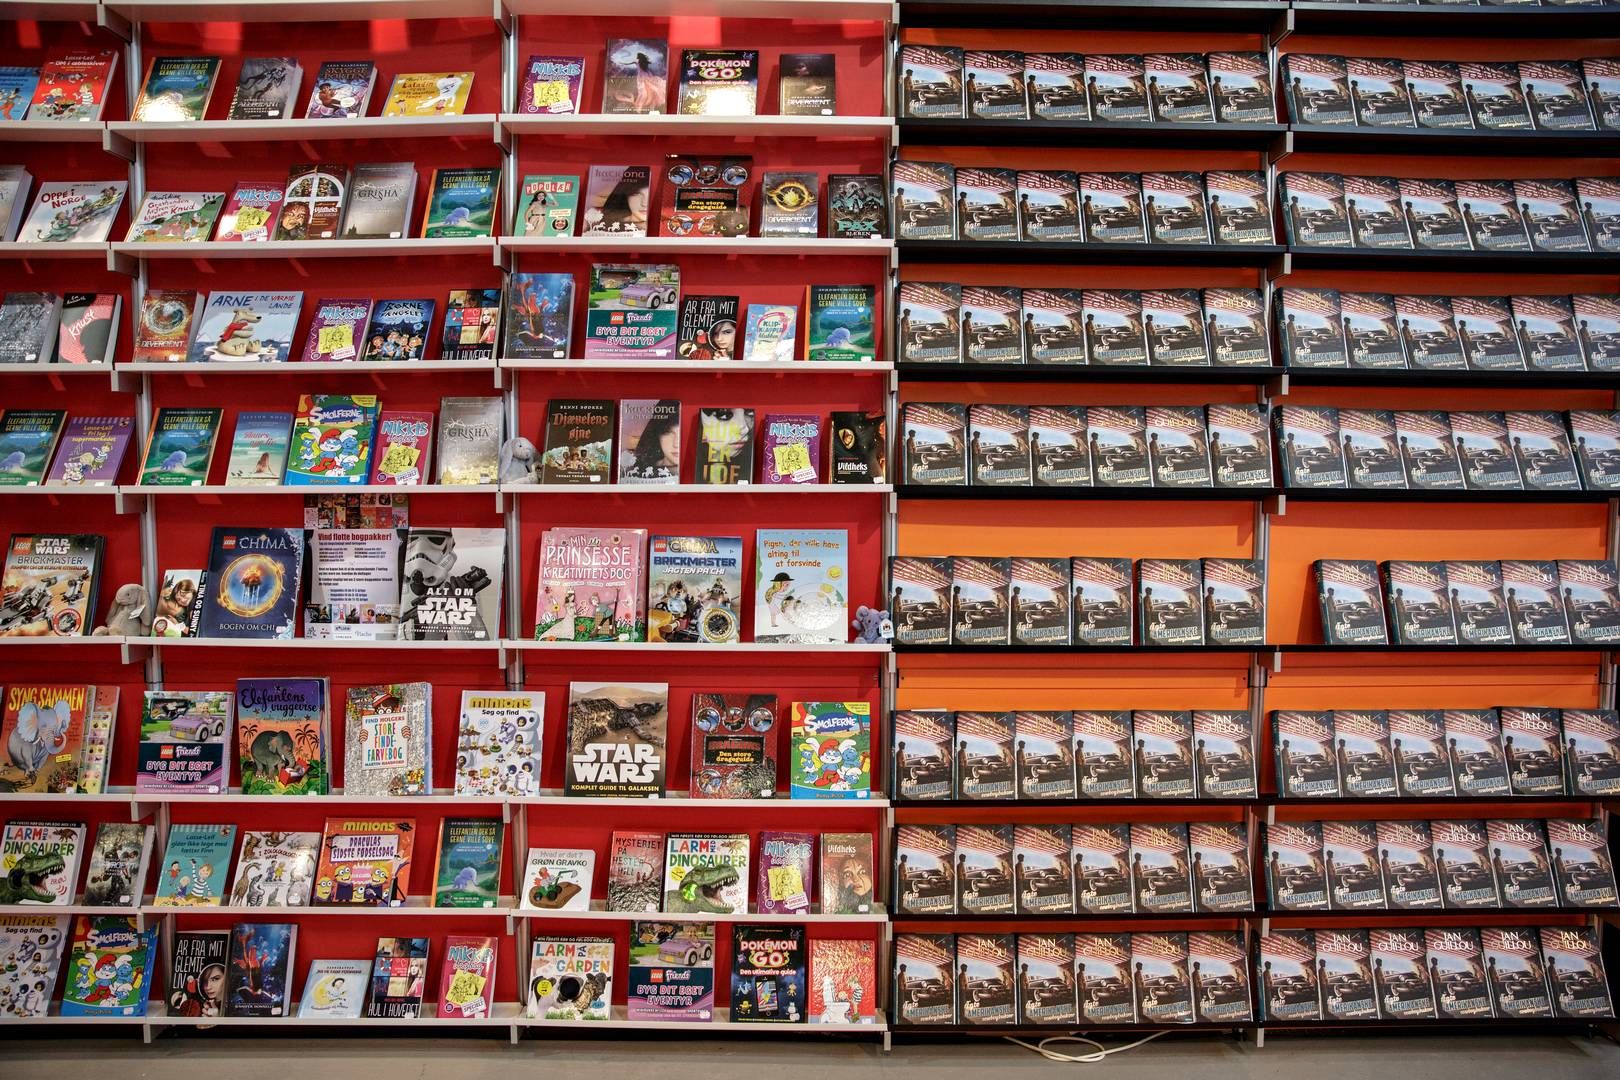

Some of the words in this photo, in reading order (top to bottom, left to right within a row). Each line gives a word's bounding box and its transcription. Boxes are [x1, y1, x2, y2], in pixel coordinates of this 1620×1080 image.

[691, 59, 750, 68] POKÉMON
[704, 68, 735, 79] GO
[526, 181, 574, 196] POPULÆR
[41, 191, 68, 203] OPPE
[358, 189, 398, 201] GRISHA
[52, 195, 87, 209] NORGE
[767, 215, 812, 224] DIVERGENT
[838, 221, 878, 232] PAX
[212, 295, 252, 307] ARNE
[268, 302, 294, 310] LANDE
[311, 408, 362, 422] SMØLFERNE
[552, 413, 609, 426] Djævelens
[381, 420, 429, 436] NIKKIS
[770, 423, 819, 438] NIKKIS
[448, 429, 489, 442] GRISHA
[837, 462, 868, 471] Vildheks
[38, 538, 71, 547] STAR
[239, 536, 288, 550] CHIMA
[318, 533, 332, 541] Vind
[333, 533, 350, 541] flotte
[351, 532, 392, 542] bogpakker!
[570, 536, 587, 547] MIN
[35, 546, 71, 554] WARS
[546, 546, 631, 566] PRINSESSE
[767, 550, 788, 559] alting
[17, 556, 84, 565] BRICKMASTER
[653, 556, 736, 568] BRICKMASTER
[788, 559, 822, 568] forsvinde
[543, 567, 632, 580] KREATIVITETSBOG
[662, 567, 695, 576] JAGTEN
[197, 584, 206, 598] TINA
[427, 588, 449, 596] ALT
[455, 588, 474, 596] OM
[418, 597, 476, 611] STAR
[418, 611, 476, 625] WARS
[9, 687, 38, 711] SYNG
[38, 688, 85, 711] SAMMEN
[240, 688, 306, 712] Elefantens
[470, 697, 533, 709] minions
[1214, 715, 1232, 724] JAN
[1522, 712, 1540, 721] JAN
[374, 722, 396, 735] STORE
[1202, 723, 1244, 733] GUILLOU
[1510, 719, 1552, 730] GUILLOU
[368, 747, 403, 762] FARVEBOG
[573, 743, 661, 763] STAR
[169, 760, 188, 771] DIT
[156, 771, 202, 782] EVENTYR
[573, 763, 661, 783] WARS
[1209, 780, 1251, 791] AMERIKANSKE
[1515, 776, 1560, 786] AMERIKANSKE
[343, 821, 396, 832] minions
[1450, 823, 1468, 833] JAN
[6, 827, 43, 841] LARM
[1440, 832, 1481, 843] GUILLOU
[349, 836, 381, 847] DRACULAS
[615, 837, 662, 850] MYSTERIET
[3, 840, 74, 856] DINOSAURER
[333, 846, 355, 859] SIDSTE
[356, 845, 394, 859] FØDSELSDAG
[828, 844, 856, 853] Vildheks
[531, 858, 554, 866] GRØN
[556, 859, 587, 867] GRAVKO
[1333, 933, 1350, 943] JAN
[1444, 932, 1462, 942] JAN
[191, 939, 206, 957] FRA
[209, 940, 225, 957] MIT
[536, 944, 576, 957] LARM
[741, 938, 797, 951] POKÉMON
[1322, 942, 1363, 953] GUILLOU
[1434, 940, 1474, 951] GUILLOU
[448, 946, 494, 962] NIKKIS
[753, 952, 784, 965] GO
[175, 956, 204, 974] GLEMTE
[780, 969, 797, 977] guide
[173, 973, 186, 989] LIV
[368, 1003, 382, 1017] HUL
